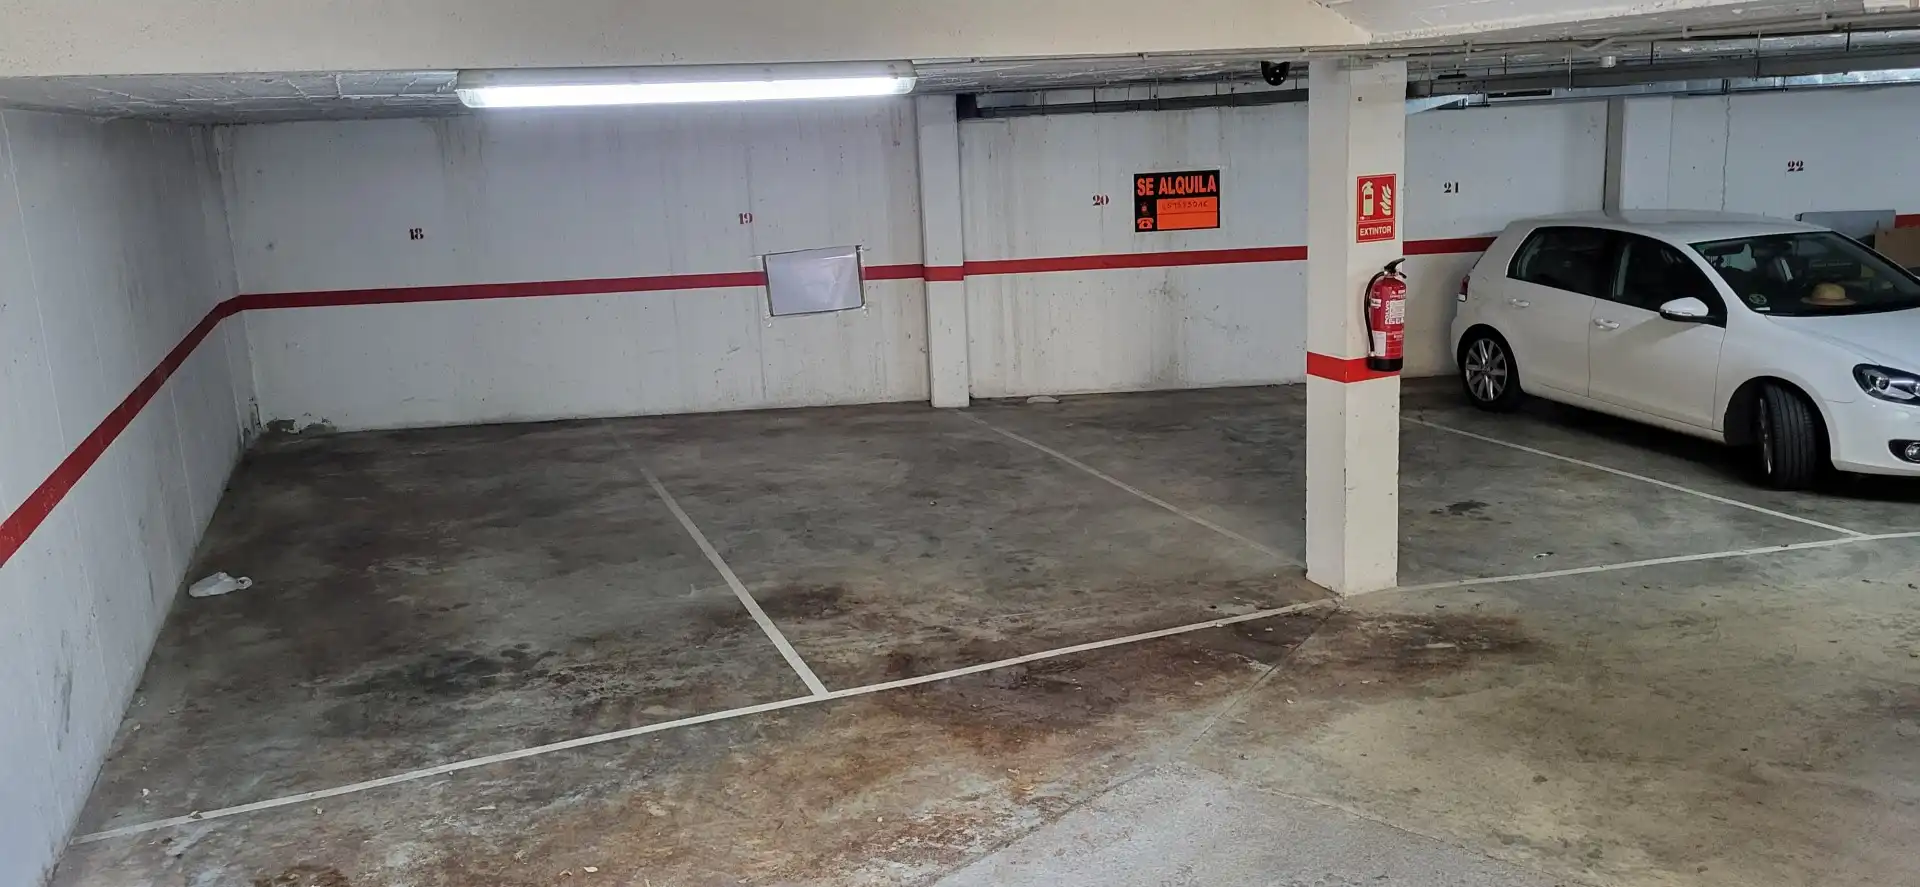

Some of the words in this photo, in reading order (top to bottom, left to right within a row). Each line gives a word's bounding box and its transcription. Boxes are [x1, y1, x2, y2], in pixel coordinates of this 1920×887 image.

[1787, 160, 1804, 172] 22
[1136, 177, 1155, 196] SE
[1158, 174, 1217, 195] ALQUILA
[1443, 182, 1459, 193] 21
[1092, 194, 1110, 206] 20
[739, 212, 753, 224] 19
[409, 227, 424, 240] 18
[1360, 225, 1392, 236] EXTINTOR
